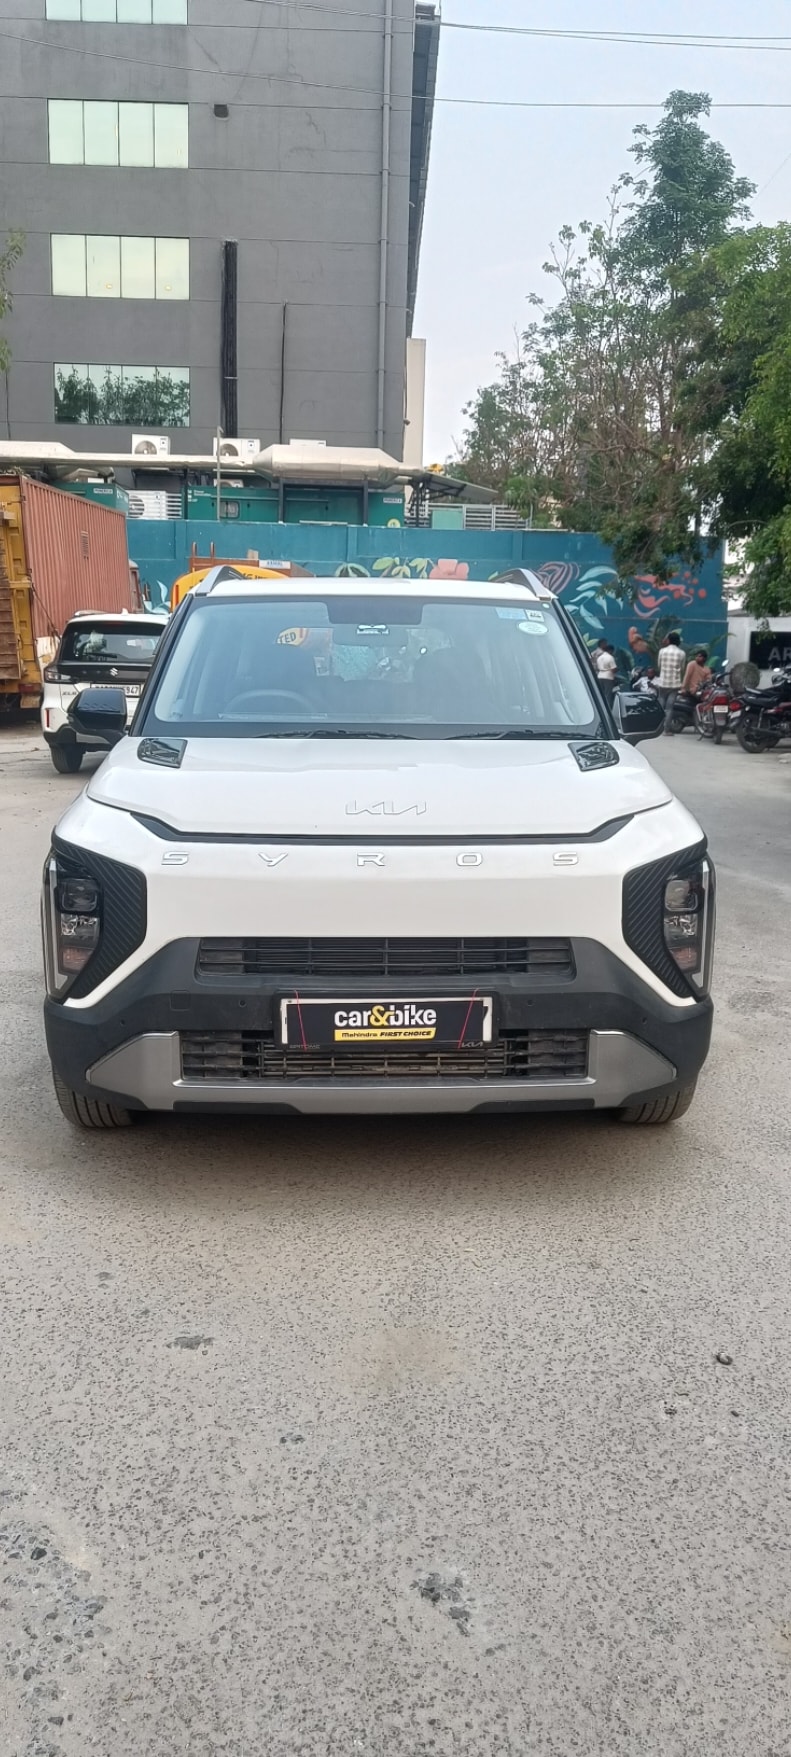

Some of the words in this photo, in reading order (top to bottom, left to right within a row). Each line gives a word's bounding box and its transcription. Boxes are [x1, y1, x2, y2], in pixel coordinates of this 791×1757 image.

[345, 800, 426, 815] KIA
[161, 851, 579, 867] SYROS
[334, 1004, 437, 1027] car&bike
